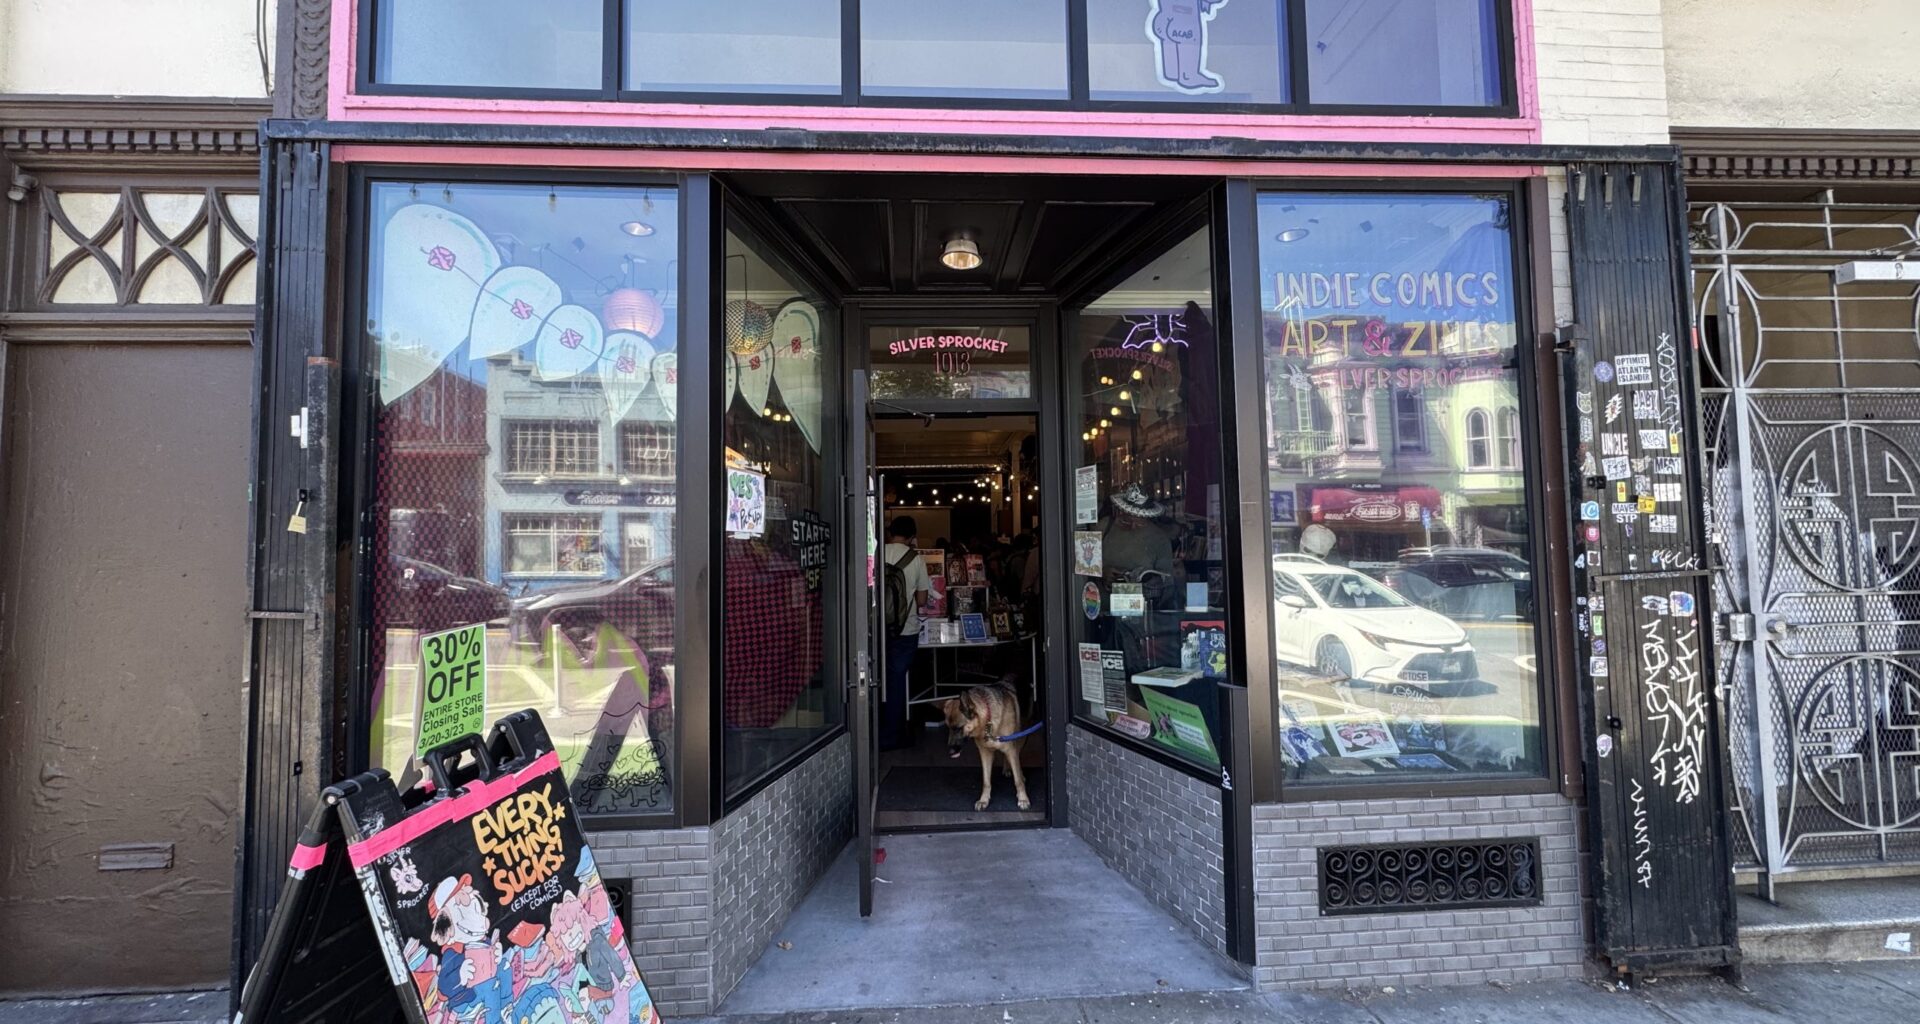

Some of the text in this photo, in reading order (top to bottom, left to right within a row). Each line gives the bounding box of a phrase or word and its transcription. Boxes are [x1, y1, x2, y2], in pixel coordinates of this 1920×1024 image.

[1171, 29, 1193, 39] ACAB
[1274, 270, 1500, 309] INDIE COMICS
[889, 335, 1009, 355] SILVER SPROCKET
[1280, 319, 1358, 358] ART
[1362, 318, 1393, 358] &
[792, 519, 831, 543] STARTS
[800, 542, 826, 568] HERE
[427, 627, 481, 669] 30%
[1102, 659, 1124, 670] ICE!
[427, 659, 481, 704] OFF
[422, 703, 483, 733] Closing Sale
[423, 692, 483, 722] ENTIRE STORE
[418, 723, 465, 749] 3/20-3/23
[471, 782, 553, 855] EVERY
[493, 838, 566, 906] SUCKS!
[397, 883, 430, 909] SPROCKET
[510, 874, 560, 913] (EXCEPT FOR
[529, 884, 563, 911] COMICS)
